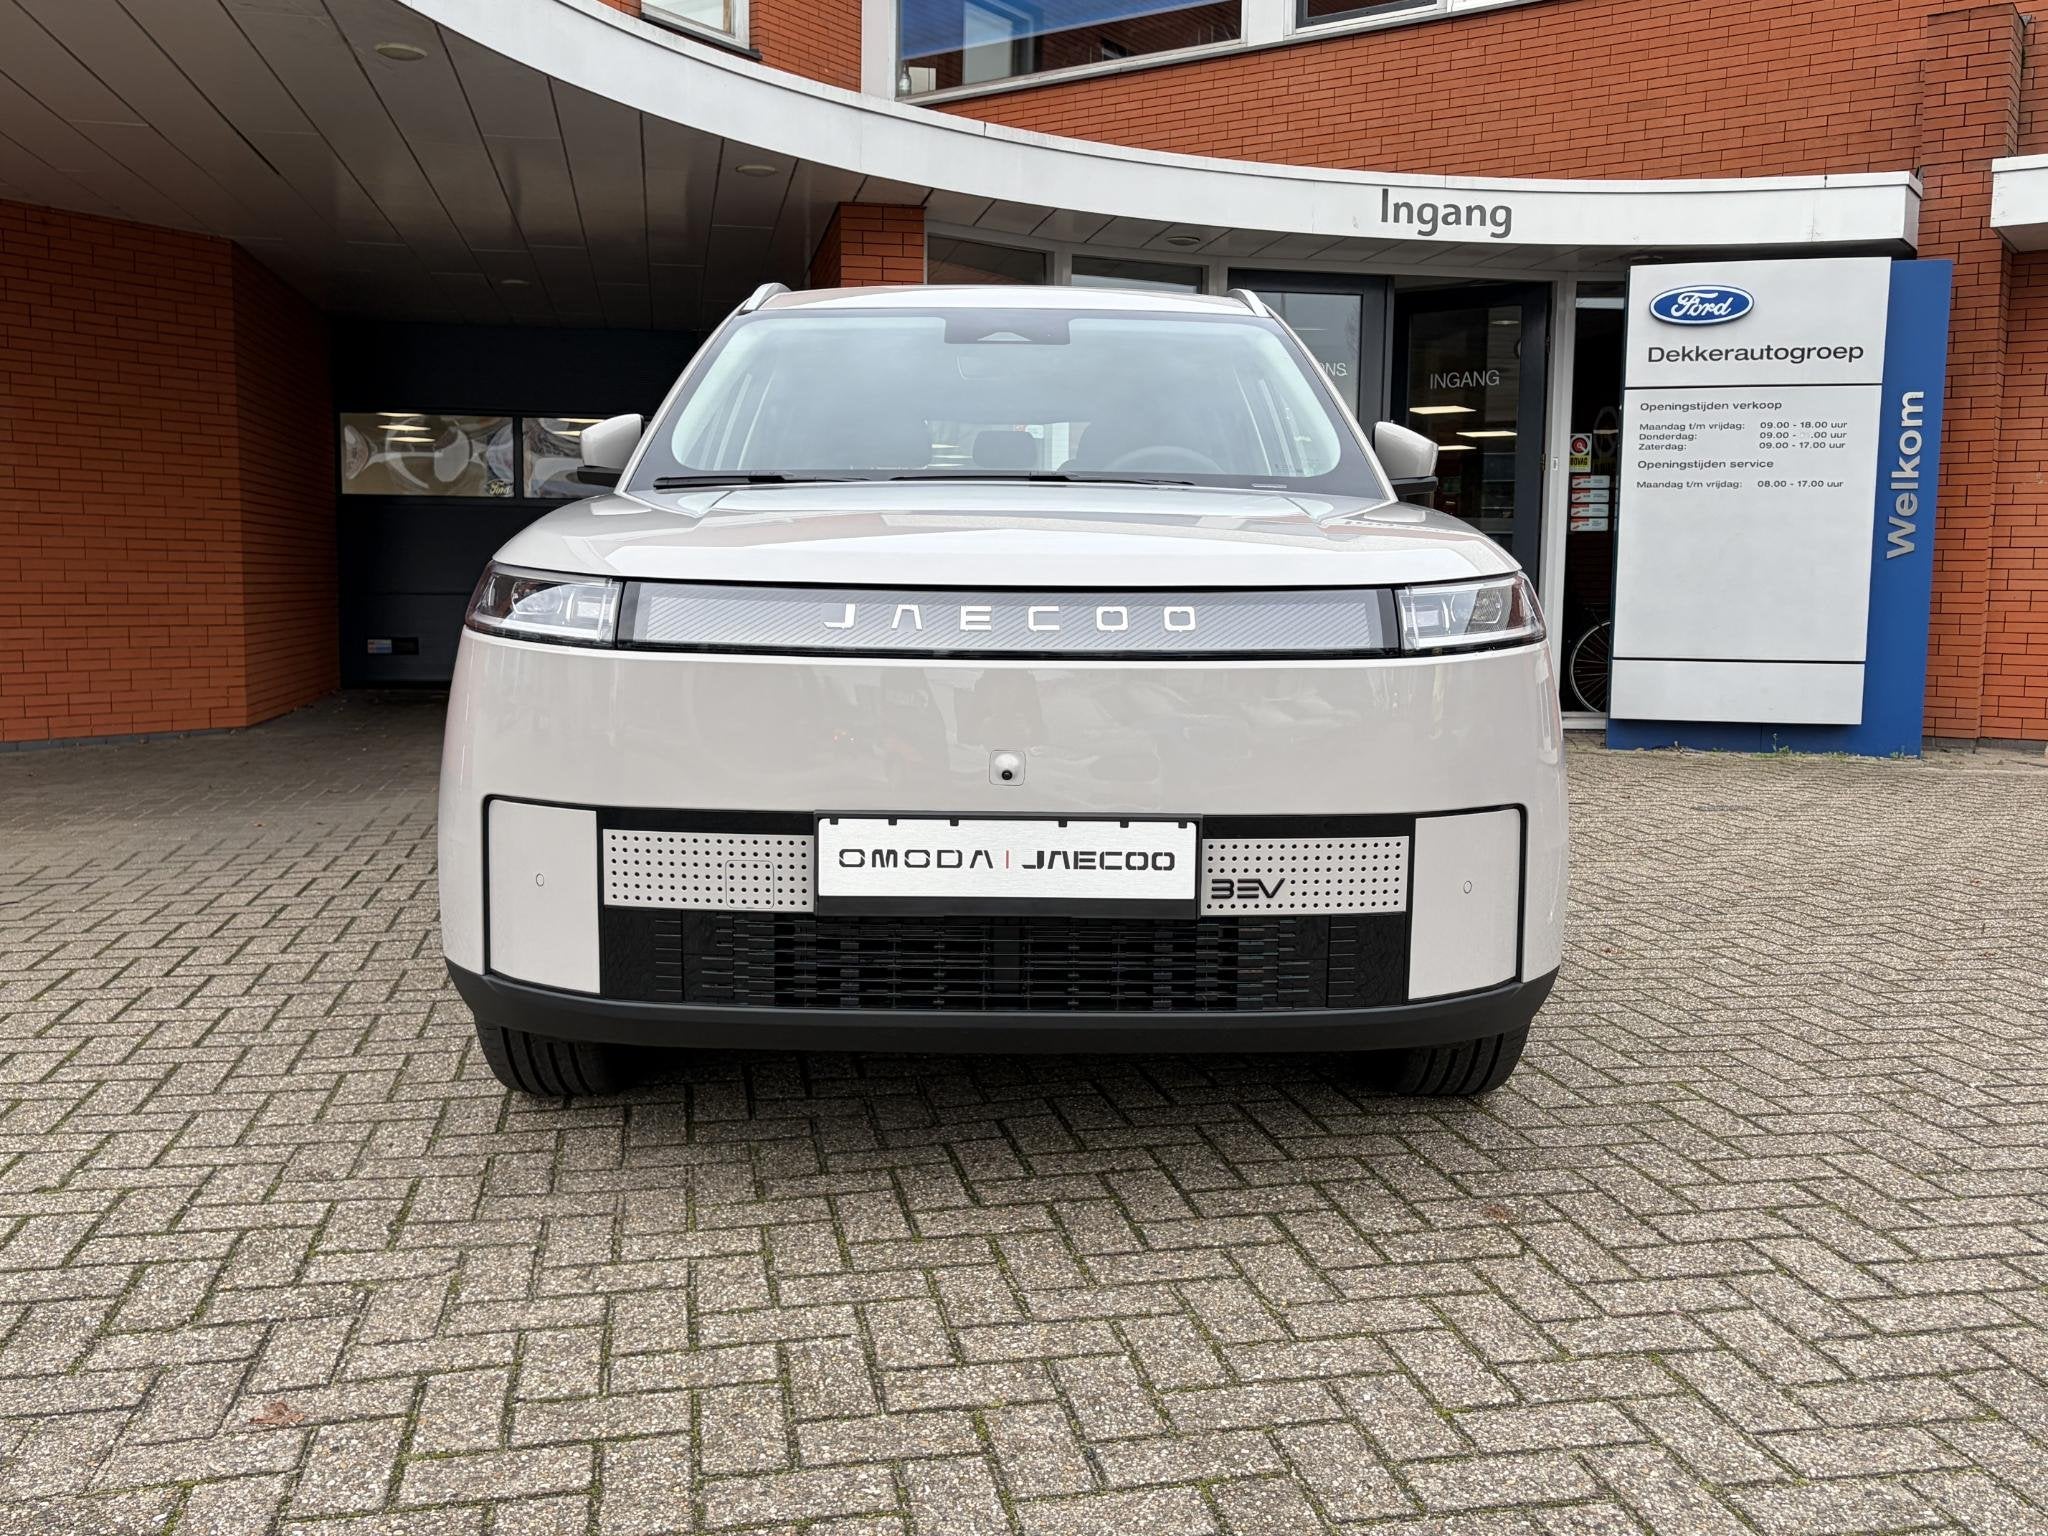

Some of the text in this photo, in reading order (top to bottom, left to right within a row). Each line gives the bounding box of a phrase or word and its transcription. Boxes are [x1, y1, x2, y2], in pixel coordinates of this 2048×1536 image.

[1381, 187, 1513, 239] Ingang
[1670, 291, 1734, 317] Ford
[1648, 344, 1865, 364] Dekkerautogroep
[1429, 369, 1500, 390] INGANG
[1640, 401, 1782, 413] Openingstijden verkoop
[1639, 423, 1686, 432] Maandag
[1708, 422, 1745, 431] vrijdag:
[1760, 421, 1790, 429] 09.00
[1800, 421, 1828, 429] 18.00
[1639, 433, 1697, 441] Donderdag:
[1760, 431, 1790, 439] 09.00
[1638, 443, 1687, 452] Zaterdag:
[1799, 441, 1826, 449] 17.00
[1637, 460, 1774, 471] Openingstijden service
[1886, 391, 1925, 559] Welkom
[1636, 481, 1684, 490] Maandag
[1686, 481, 1704, 489] t/m
[1706, 480, 1743, 489] vrijdag:
[1757, 480, 1787, 488] 08.00
[1797, 480, 1824, 488] 17.00
[823, 603, 1197, 632] JAECOO
[838, 848, 1176, 871] OMODA JAECOO
[1211, 878, 1285, 899] BEV
